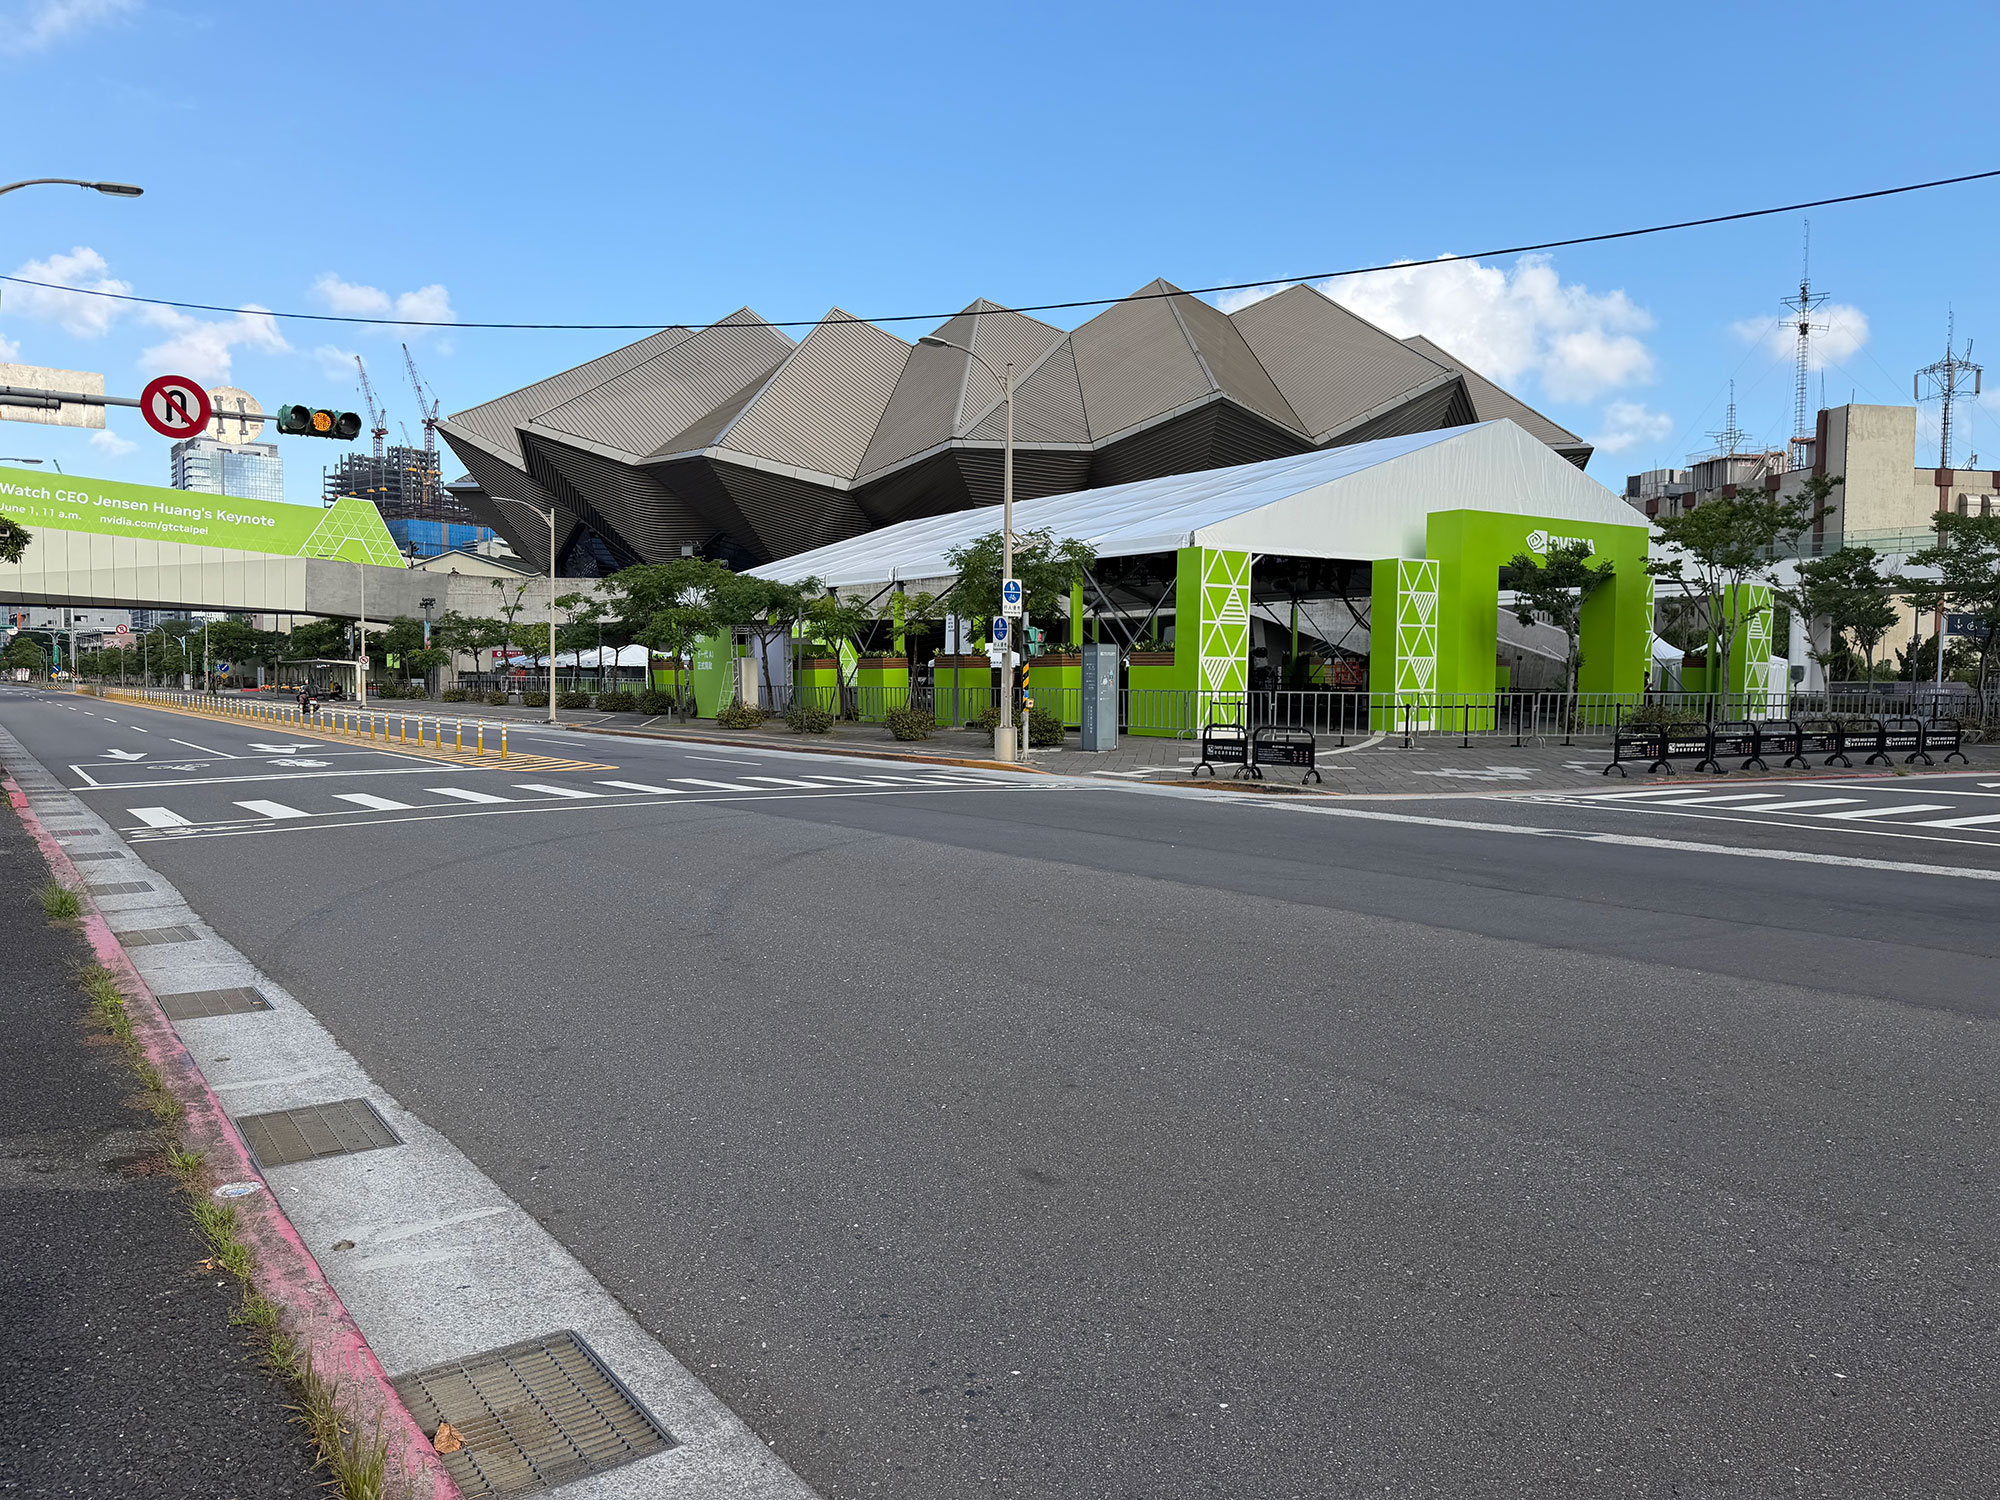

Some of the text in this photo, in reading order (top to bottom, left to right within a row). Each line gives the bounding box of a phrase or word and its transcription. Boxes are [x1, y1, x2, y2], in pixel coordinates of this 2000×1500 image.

[0, 482, 276, 527] Watch CEO Jensen Huang's Keynote
[0, 502, 209, 536] June 1, 11 a.m. nvidia.com/gtctaipei
[1549, 535, 1595, 554] NVIA
